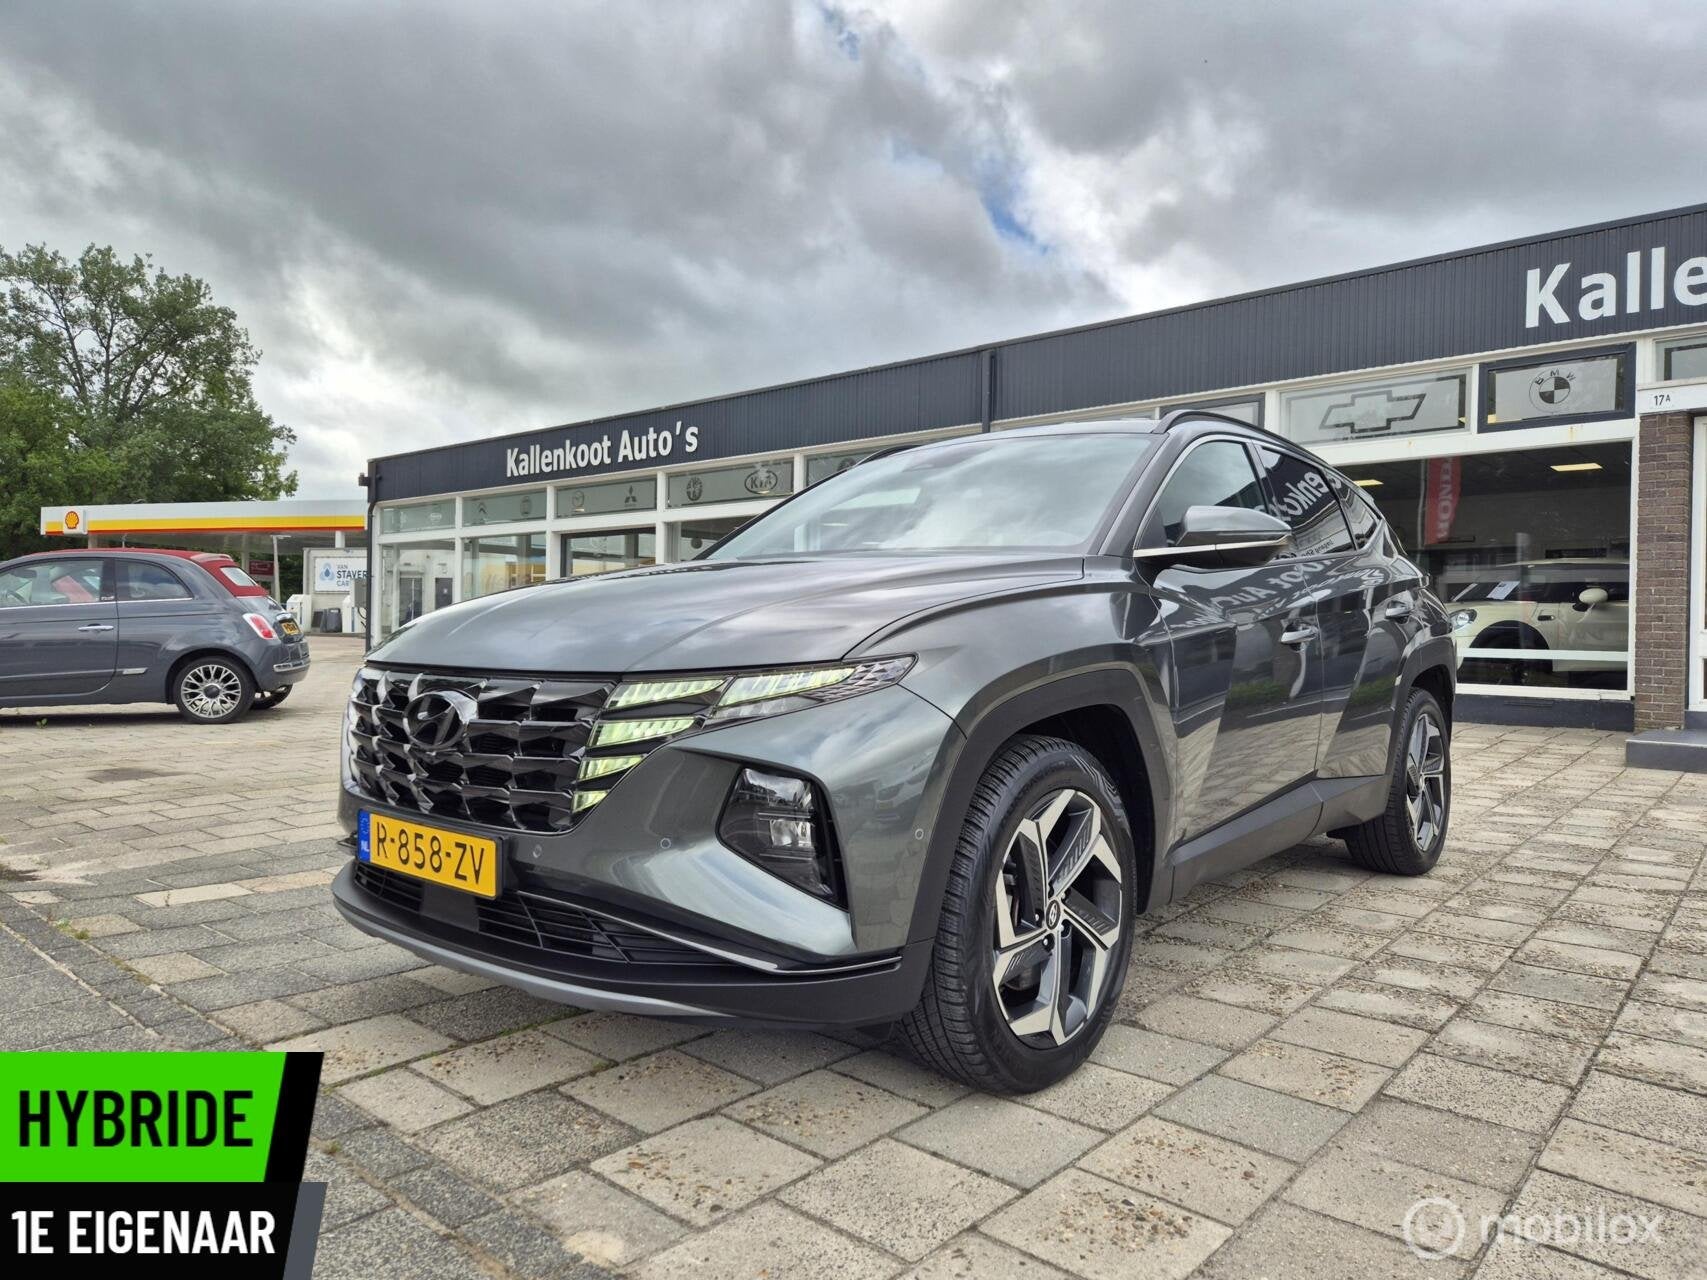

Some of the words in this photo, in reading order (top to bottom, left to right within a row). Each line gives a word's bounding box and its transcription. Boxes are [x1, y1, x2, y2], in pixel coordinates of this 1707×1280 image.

[1526, 246, 1707, 329] Kalle
[506, 434, 612, 477] Kallenkoot
[618, 420, 699, 463] Auto's
[377, 821, 485, 885] R-858-ZV
